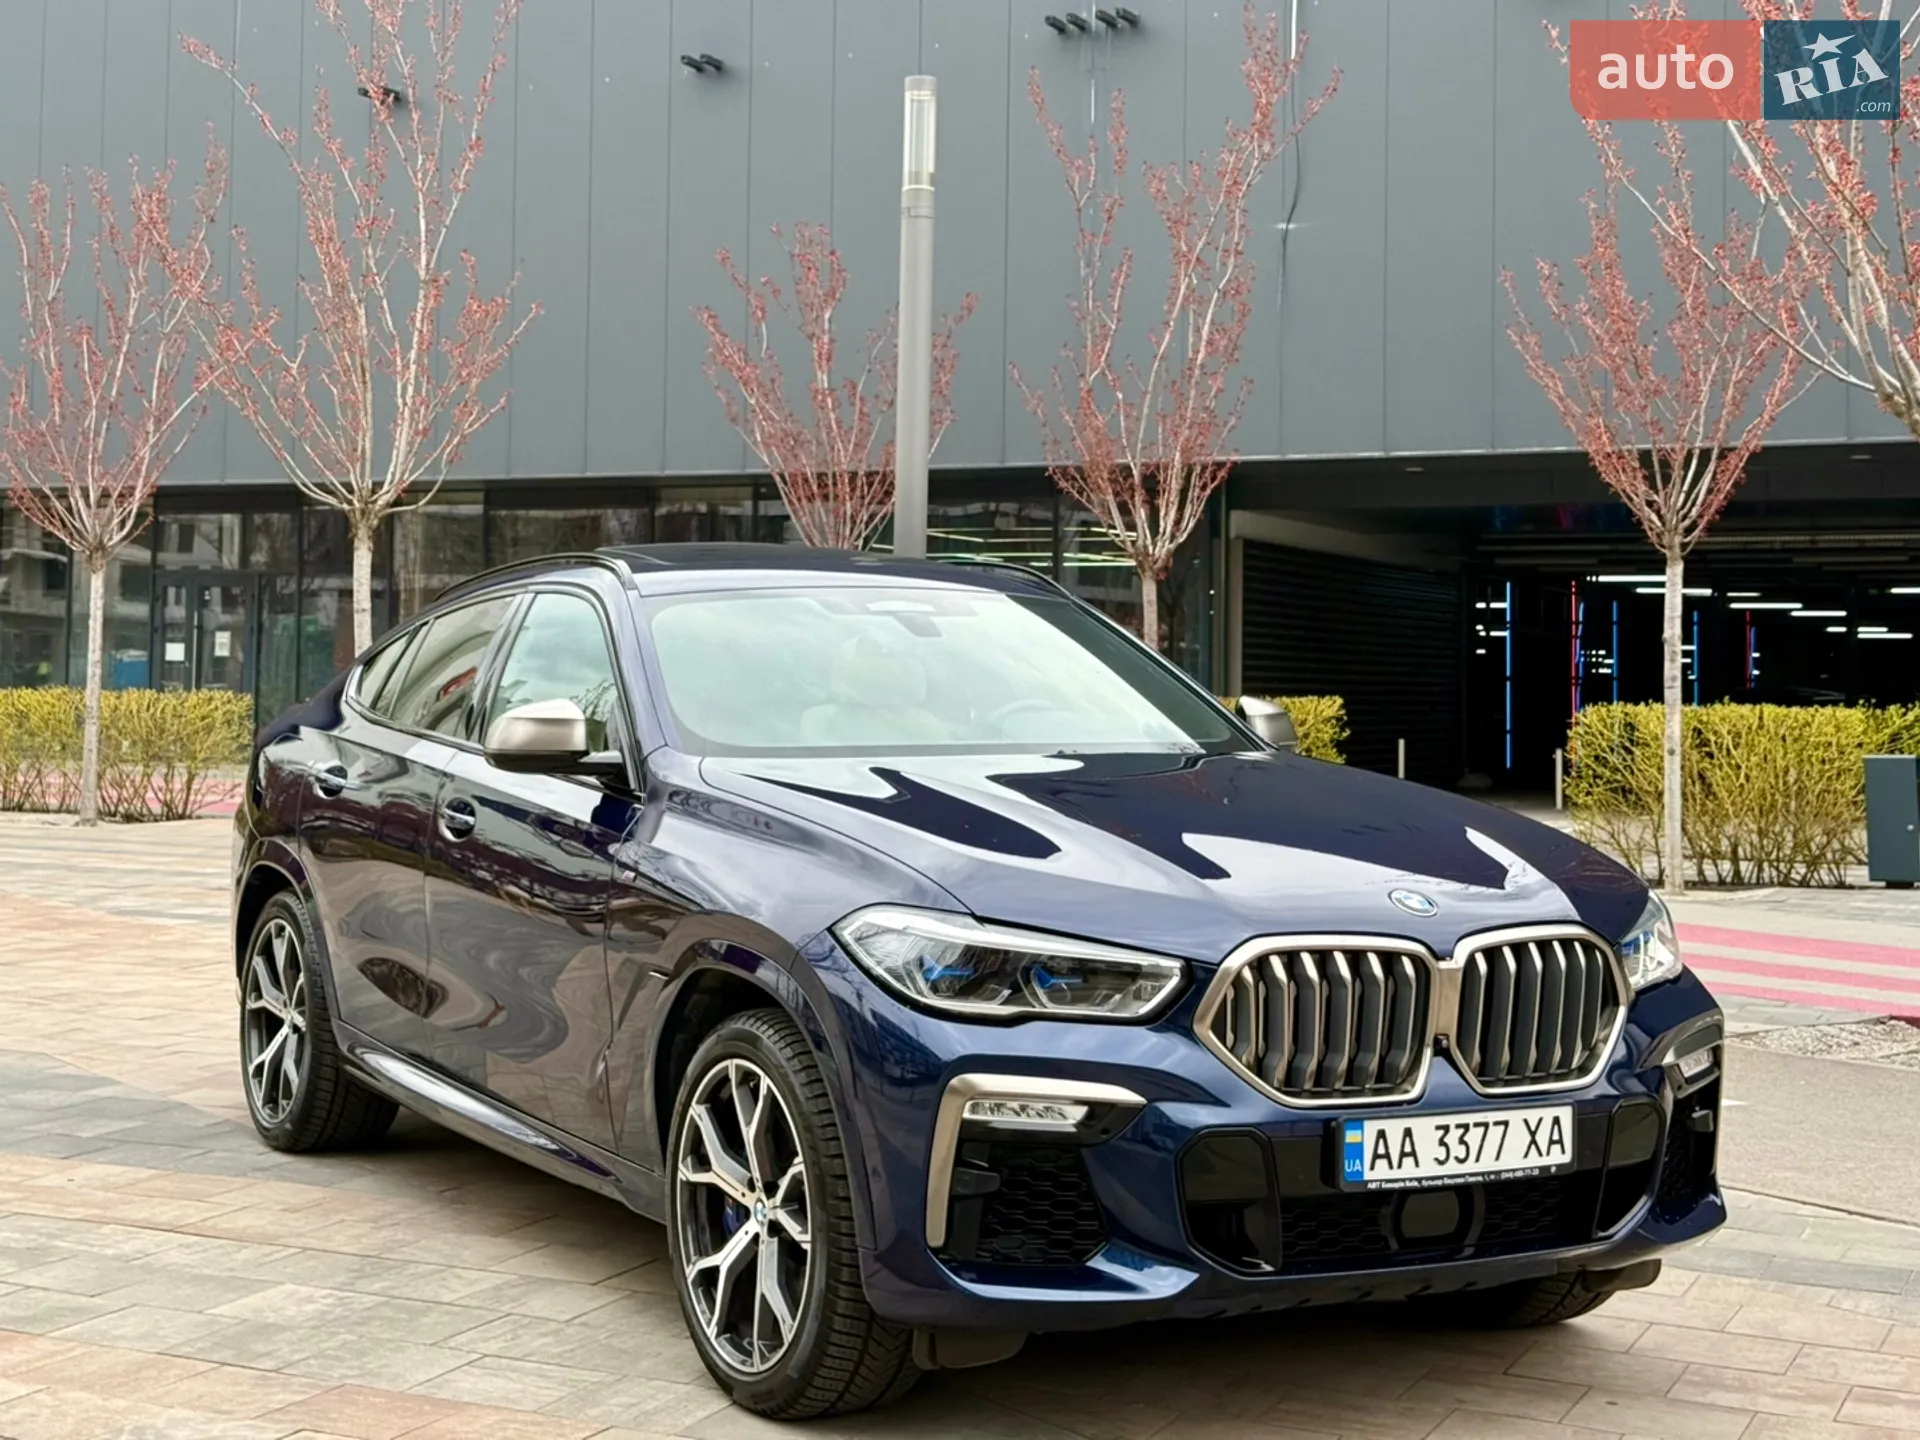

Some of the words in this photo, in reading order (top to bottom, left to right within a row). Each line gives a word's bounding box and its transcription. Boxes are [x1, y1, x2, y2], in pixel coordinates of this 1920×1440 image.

[1369, 1127, 1420, 1171] AA
[1433, 1120, 1510, 1165] 3377
[1523, 1115, 1566, 1159] XA
[1345, 1159, 1362, 1172] UA
